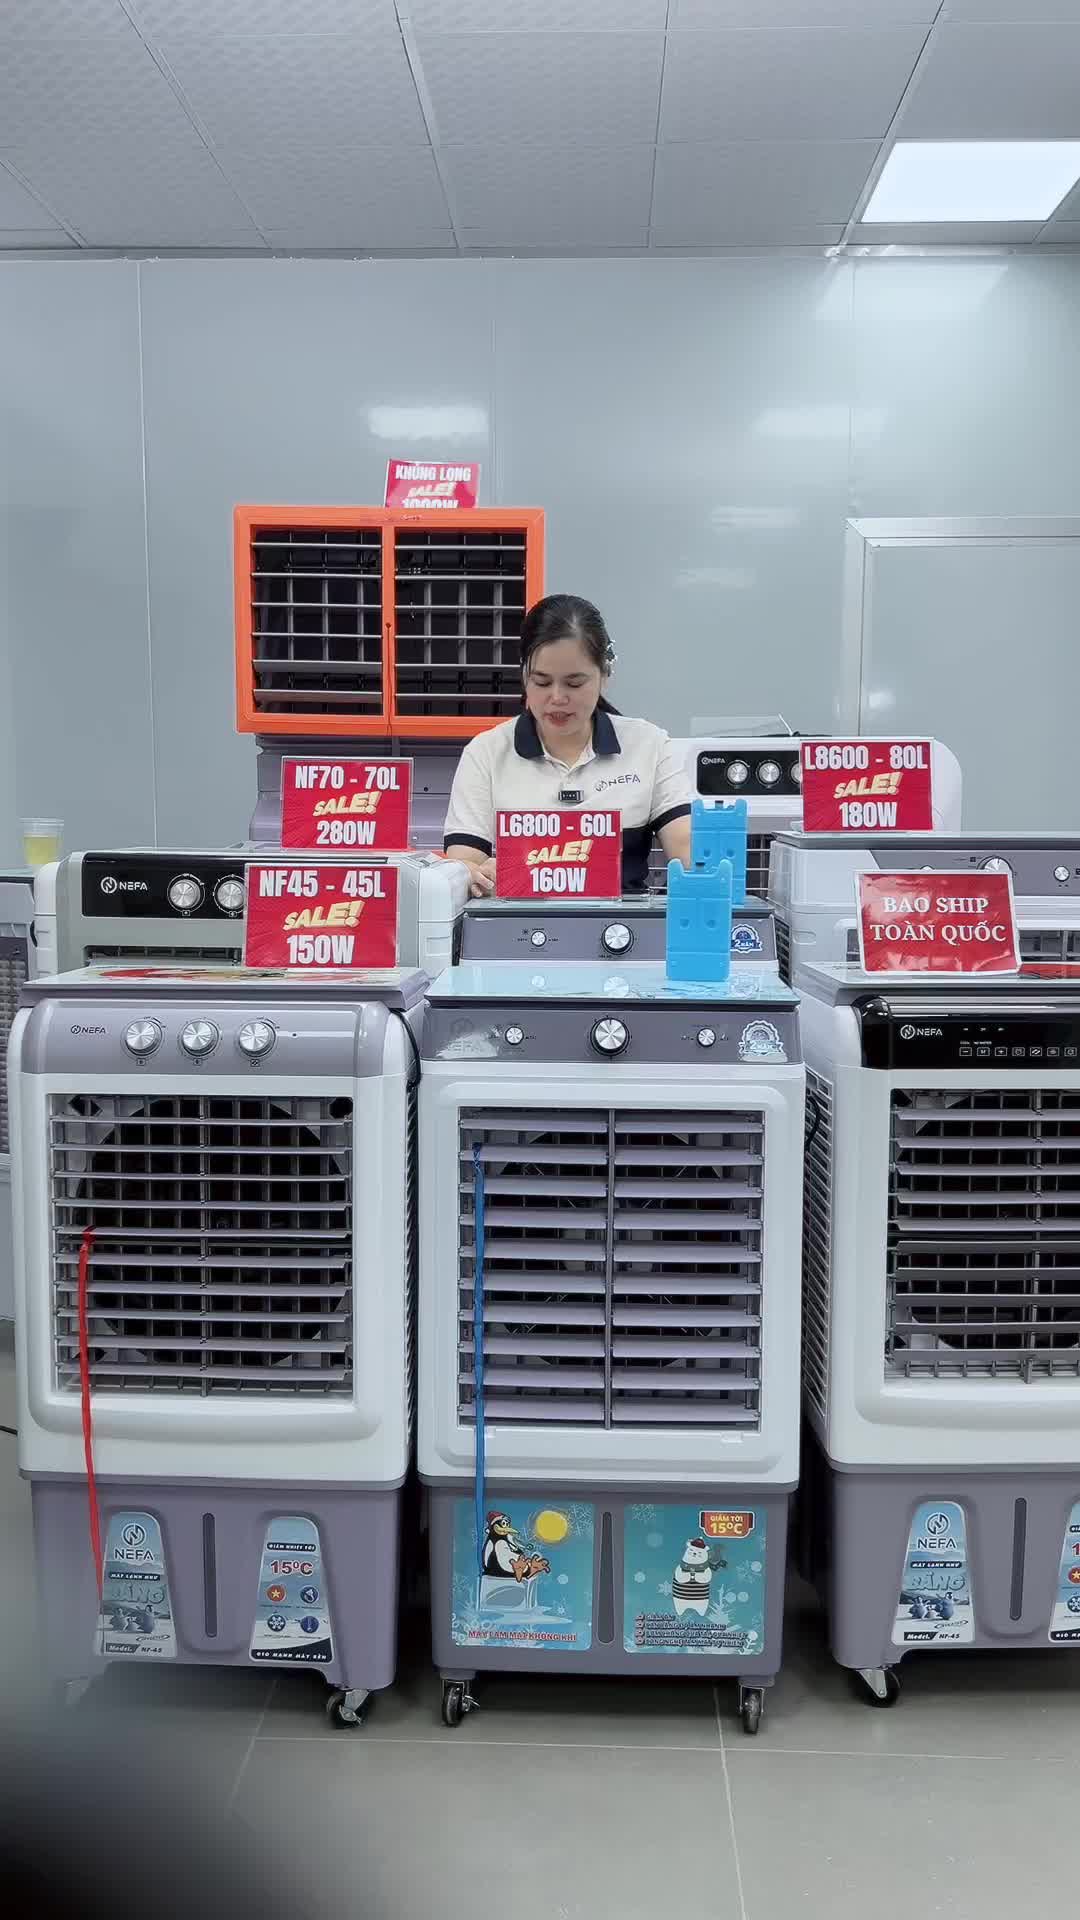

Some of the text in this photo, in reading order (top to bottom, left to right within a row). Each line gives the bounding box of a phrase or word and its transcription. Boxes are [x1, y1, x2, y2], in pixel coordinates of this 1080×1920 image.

[440, 467, 471, 482] LONG
[804, 745, 869, 770] L8600
[889, 745, 928, 769] 80L
[295, 765, 344, 789] NF70
[364, 766, 400, 790] 70L
[608, 774, 641, 786] NEFA
[833, 771, 904, 799] SALE!
[312, 790, 382, 817] SALE!
[839, 801, 898, 828] 180W
[316, 820, 376, 845] 280W
[500, 813, 560, 837] L6800
[580, 813, 616, 837] 60L
[526, 839, 593, 866] SALE!
[119, 881, 148, 891] NEFA
[259, 869, 318, 897] NF45
[342, 870, 386, 898] 45L
[529, 867, 587, 893] 160W
[282, 900, 366, 931] SALE!
[883, 896, 989, 915] BAO SHIP
[869, 920, 1007, 946] TOÀN QUỐC
[286, 934, 355, 965] 150W
[916, 1028, 943, 1036] NEFA
[114, 1548, 154, 1561] NEFA
[917, 1538, 957, 1549] NEFA
